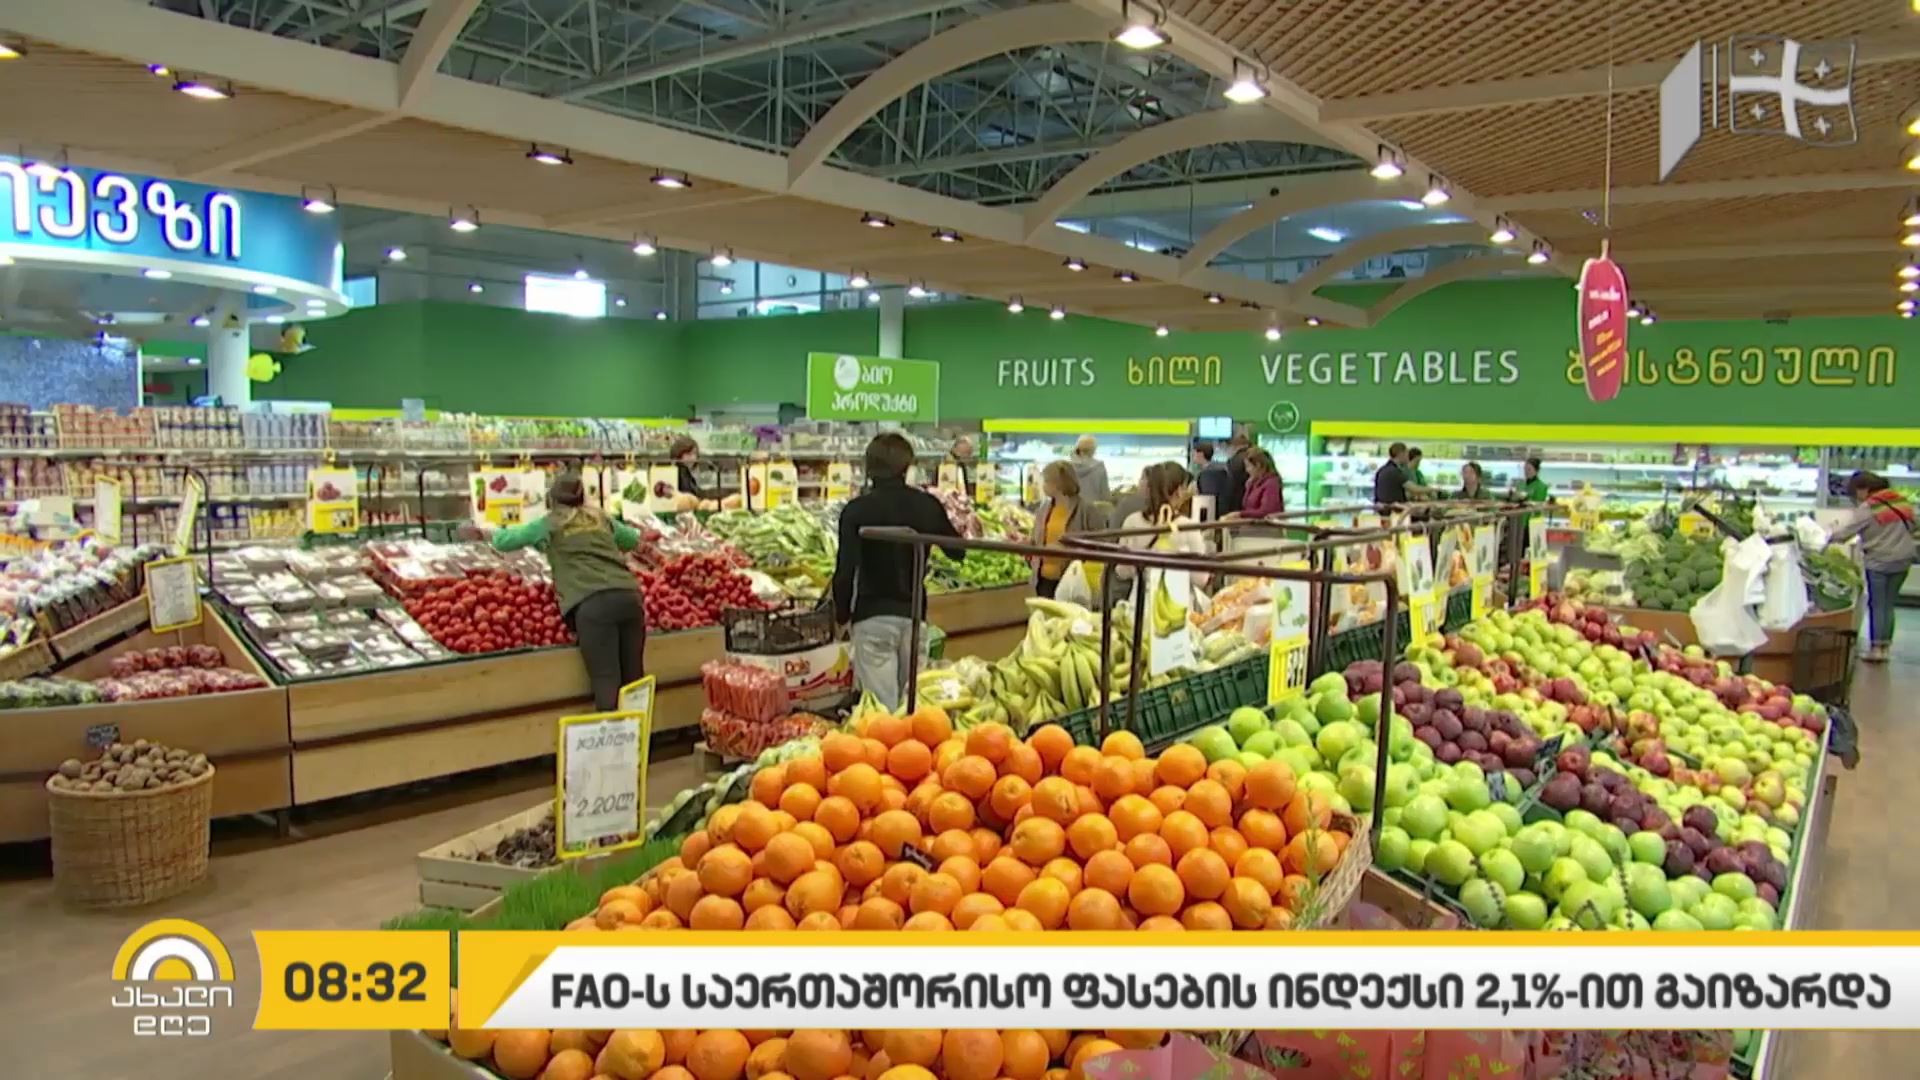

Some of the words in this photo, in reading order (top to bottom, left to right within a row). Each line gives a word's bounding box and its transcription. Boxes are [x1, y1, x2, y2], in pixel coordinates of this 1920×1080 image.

[862, 364, 893, 385] ბიო
[998, 357, 1095, 387] FRUITS
[1127, 355, 1221, 385] ხილი
[1260, 350, 1519, 386] VEGETABLES
[1565, 345, 1897, 386] ბსტნეული
[831, 390, 918, 414] პროდუქტი
